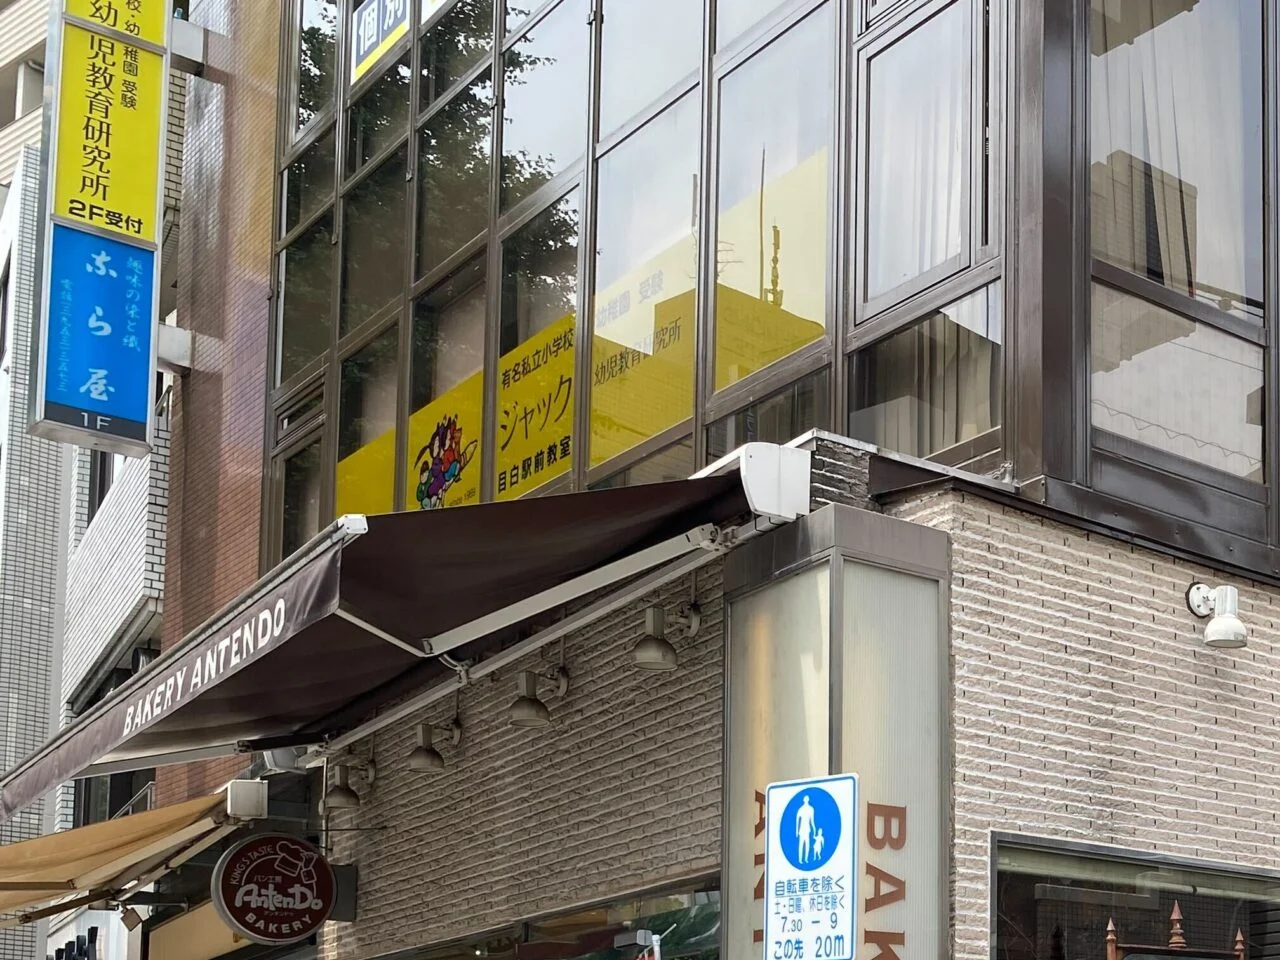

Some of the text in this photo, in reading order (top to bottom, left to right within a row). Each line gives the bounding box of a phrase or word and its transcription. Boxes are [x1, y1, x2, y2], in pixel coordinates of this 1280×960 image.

[120, 79, 138, 111] 受験
[68, 199, 144, 235] 2F受付
[501, 328, 574, 390] 有名私立小学校
[80, 412, 111, 430] 1F
[500, 375, 572, 451] ジャック
[498, 435, 571, 493] 目白駅前教室
[123, 598, 285, 737] BAKERY ANTENDO
[248, 845, 273, 860] TASTE
[775, 875, 845, 896] 自転車を除く
[245, 912, 312, 933] BAKERY
[781, 916, 803, 933] 7.30
[830, 912, 838, 929] 9
[774, 934, 845, 960] この先 20m
